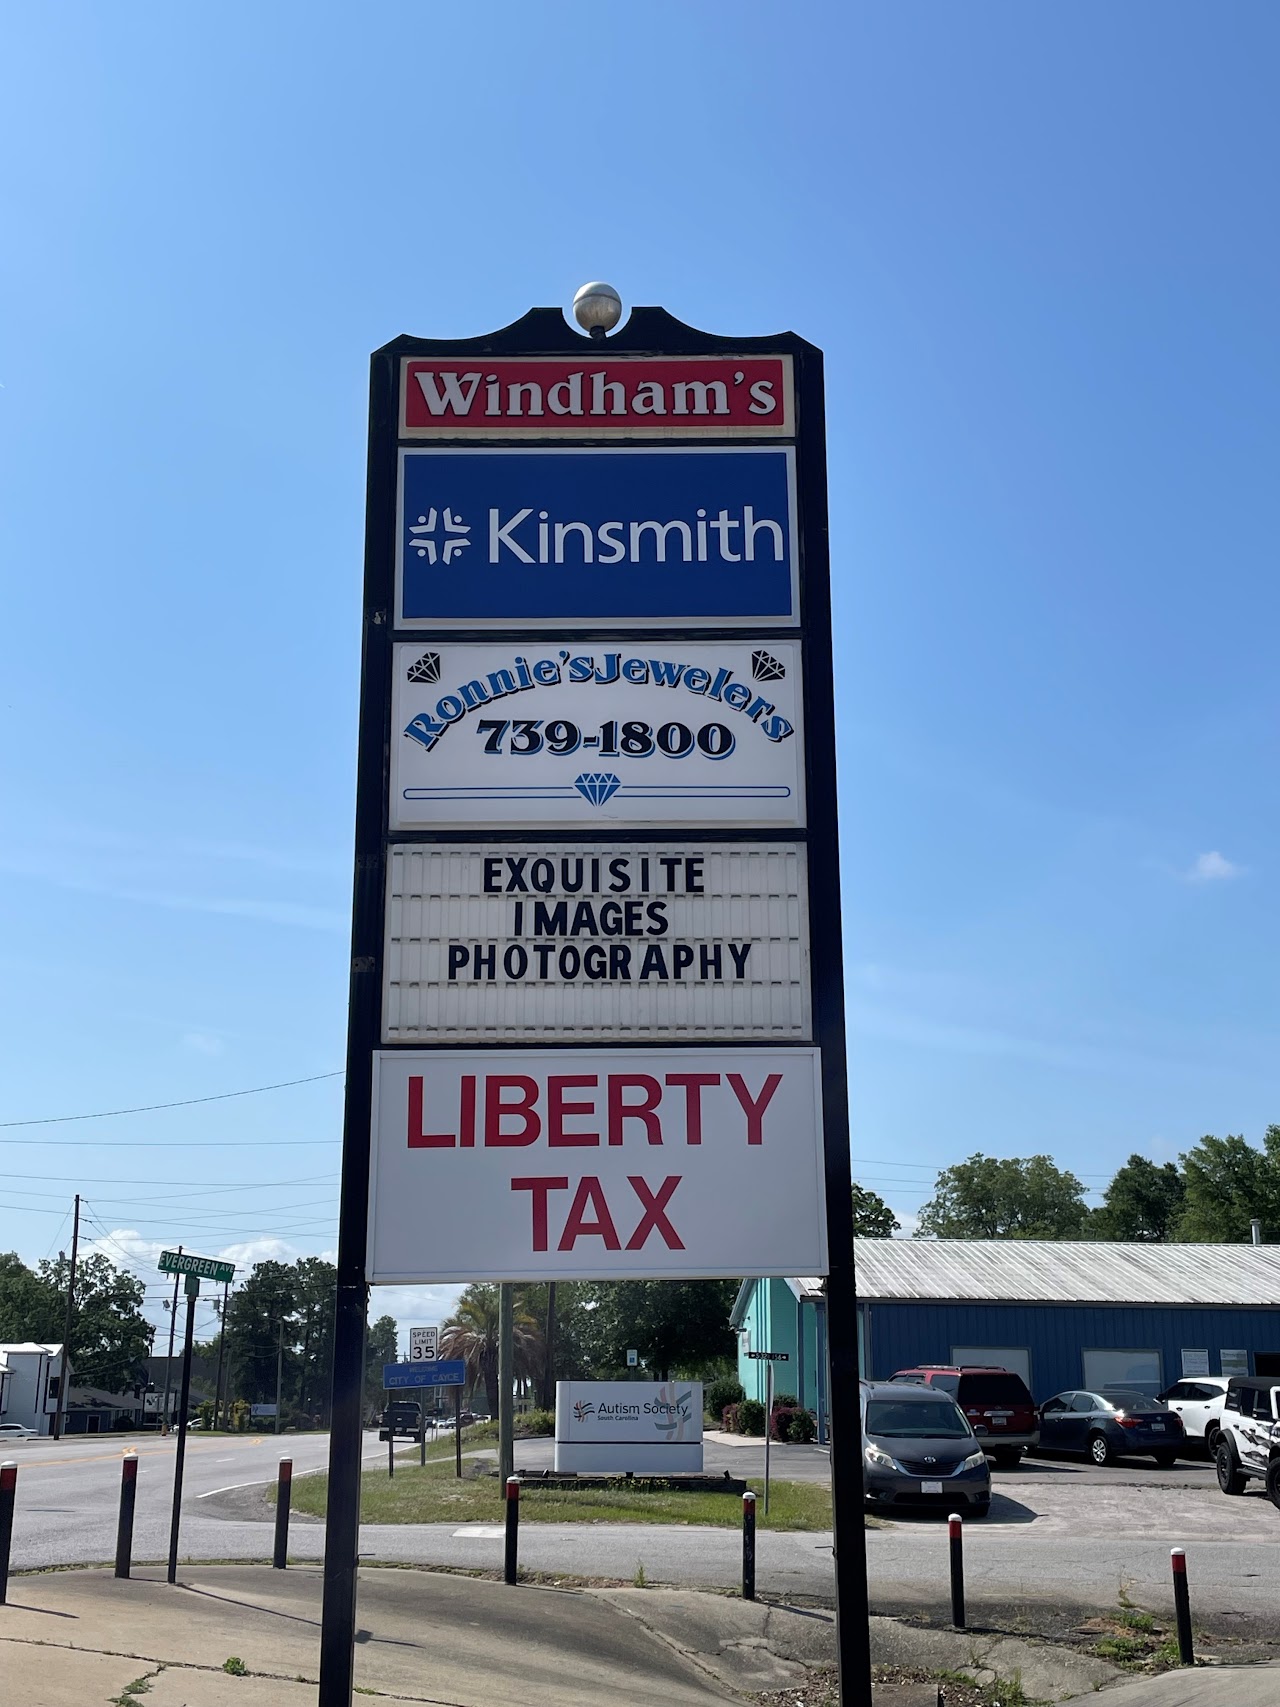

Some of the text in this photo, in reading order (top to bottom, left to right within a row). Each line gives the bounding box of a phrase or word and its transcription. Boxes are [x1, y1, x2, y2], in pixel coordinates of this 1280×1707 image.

[414, 371, 777, 416] Windham's
[489, 506, 784, 564] Kinsmith
[403, 650, 795, 752] Ronnie's Jewelers
[476, 719, 736, 760] 739-1800
[483, 857, 705, 893] EXQUISITE
[513, 901, 669, 936] IMAGES
[448, 943, 752, 980] PHOTOGRAPHY
[407, 1073, 783, 1148] LIBERTY
[511, 1175, 686, 1252] TAX
[159, 1252, 235, 1276] EVERGREEN AVE
[413, 1346, 435, 1360] 35
[389, 1373, 460, 1386] CITY OF CAYCE
[598, 1402, 689, 1417] Autism Society
